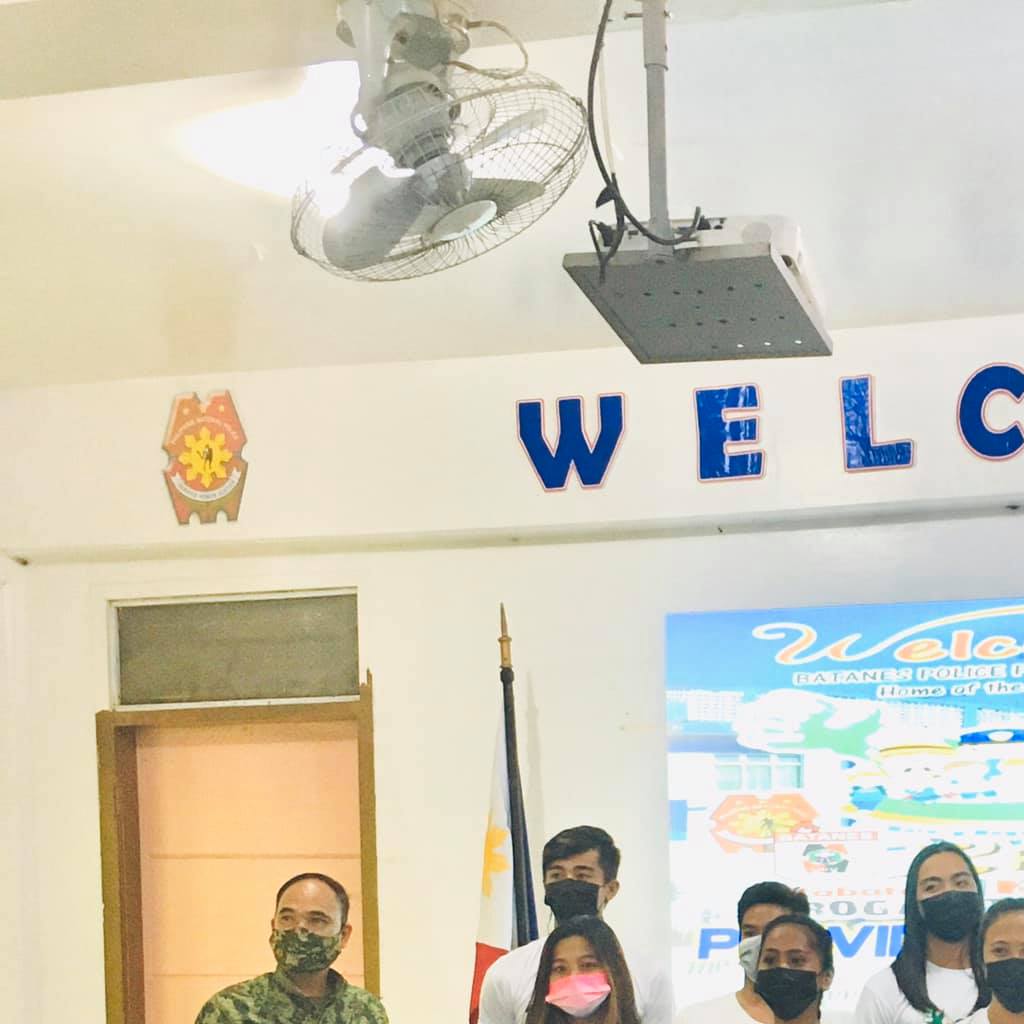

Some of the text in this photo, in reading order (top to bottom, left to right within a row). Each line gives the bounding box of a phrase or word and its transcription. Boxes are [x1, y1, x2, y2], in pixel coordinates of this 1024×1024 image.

[796, 670, 910, 685] BATANES
[920, 666, 1005, 681] POLICE
[879, 684, 943, 698] Home
[954, 683, 977, 697] of
[986, 681, 1024, 695] the
